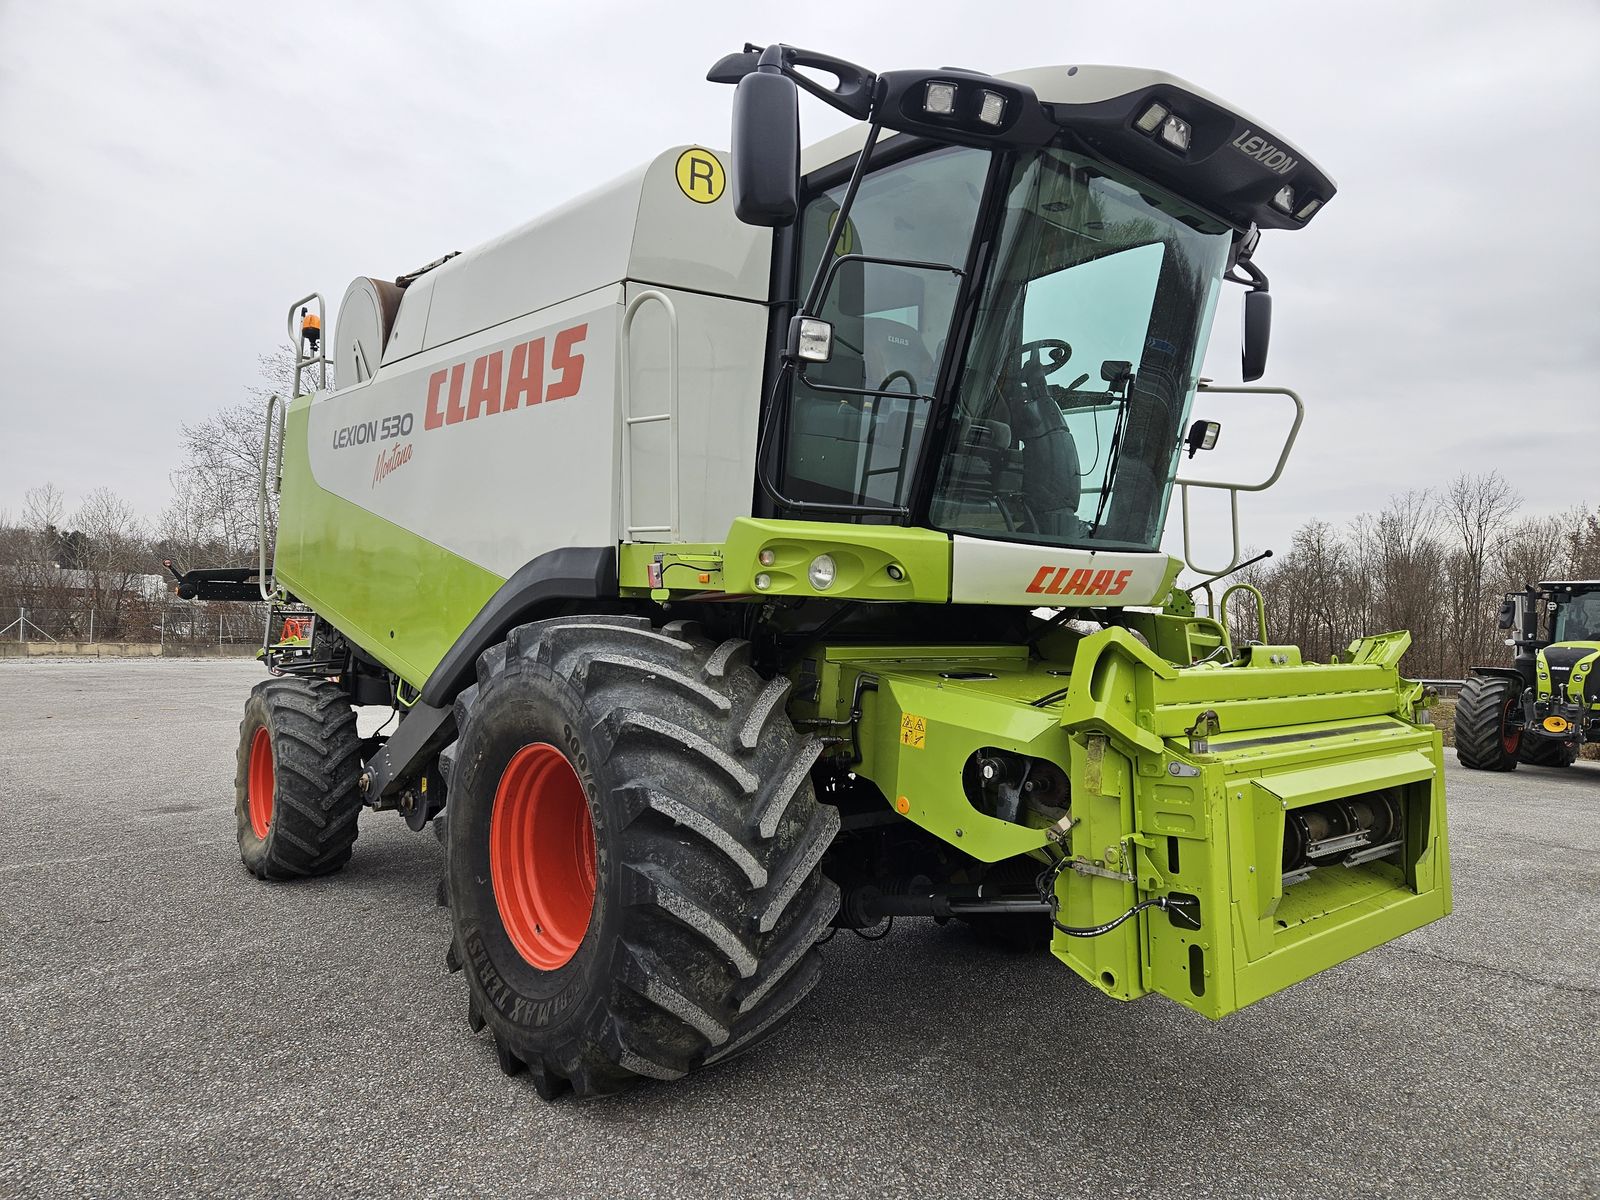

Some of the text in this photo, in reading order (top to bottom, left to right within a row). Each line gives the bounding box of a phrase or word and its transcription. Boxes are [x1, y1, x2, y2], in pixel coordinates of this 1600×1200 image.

[1232, 129, 1298, 174] LEXION
[690, 157, 714, 195] R
[424, 323, 589, 431] CLAAS
[333, 412, 414, 450] LEXION 530
[371, 441, 413, 490] Montana
[1025, 565, 1134, 596] CLAAS
